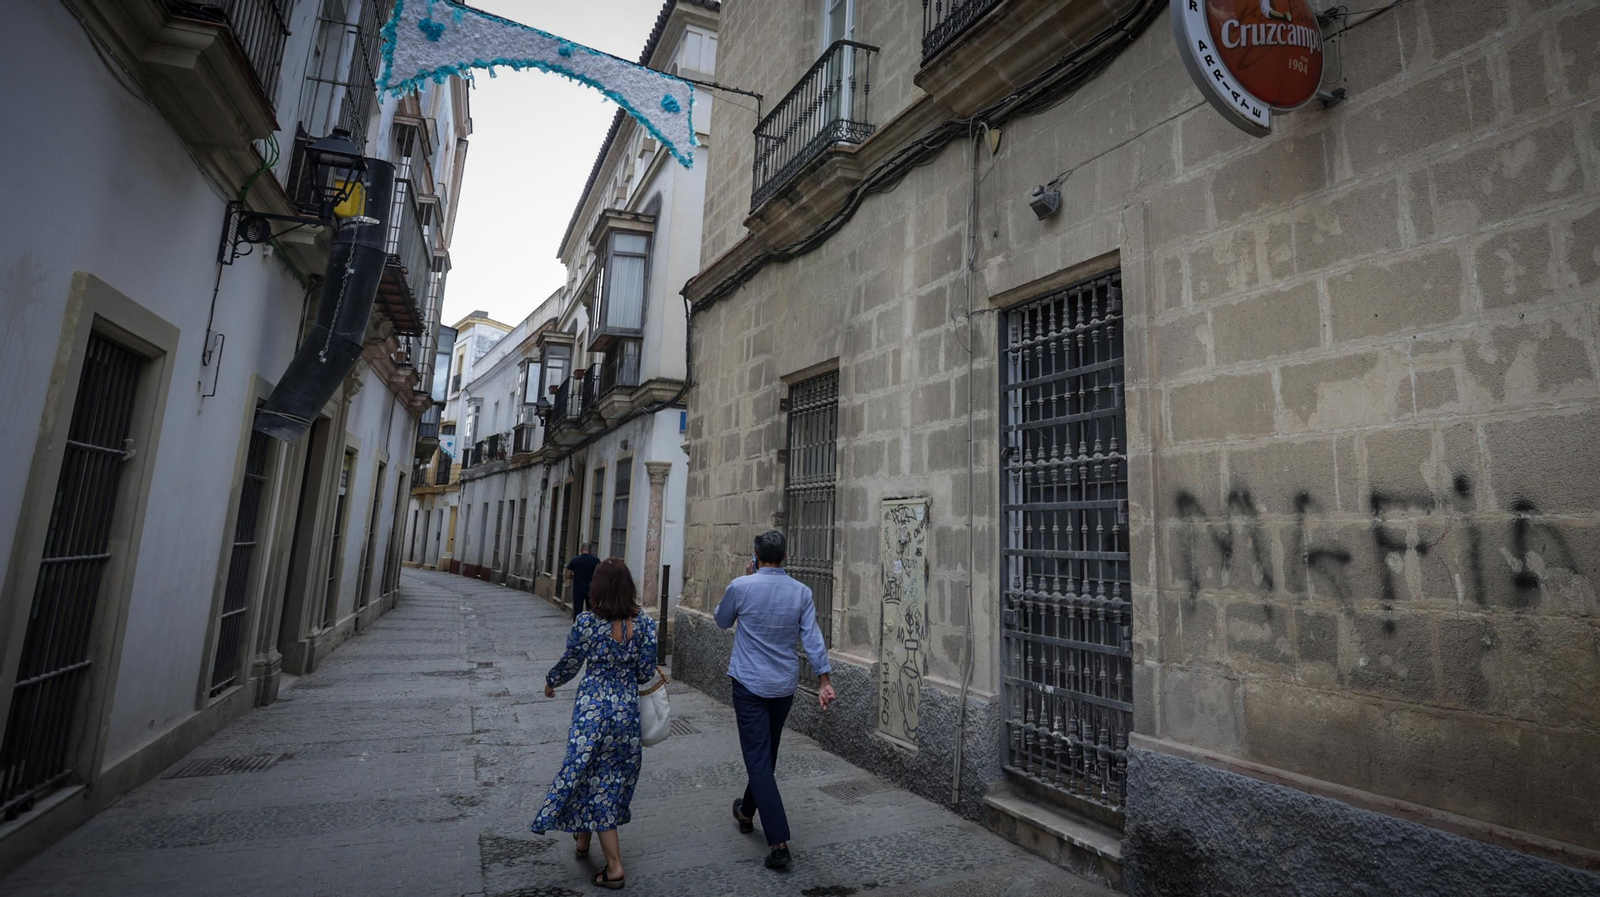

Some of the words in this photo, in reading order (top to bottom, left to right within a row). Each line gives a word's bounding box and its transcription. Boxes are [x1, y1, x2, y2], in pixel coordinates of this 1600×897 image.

[1221, 19, 1322, 54] Cruzcampo
[1199, 40, 1262, 118] ARRIATE
[1288, 58, 1308, 75] 1904
